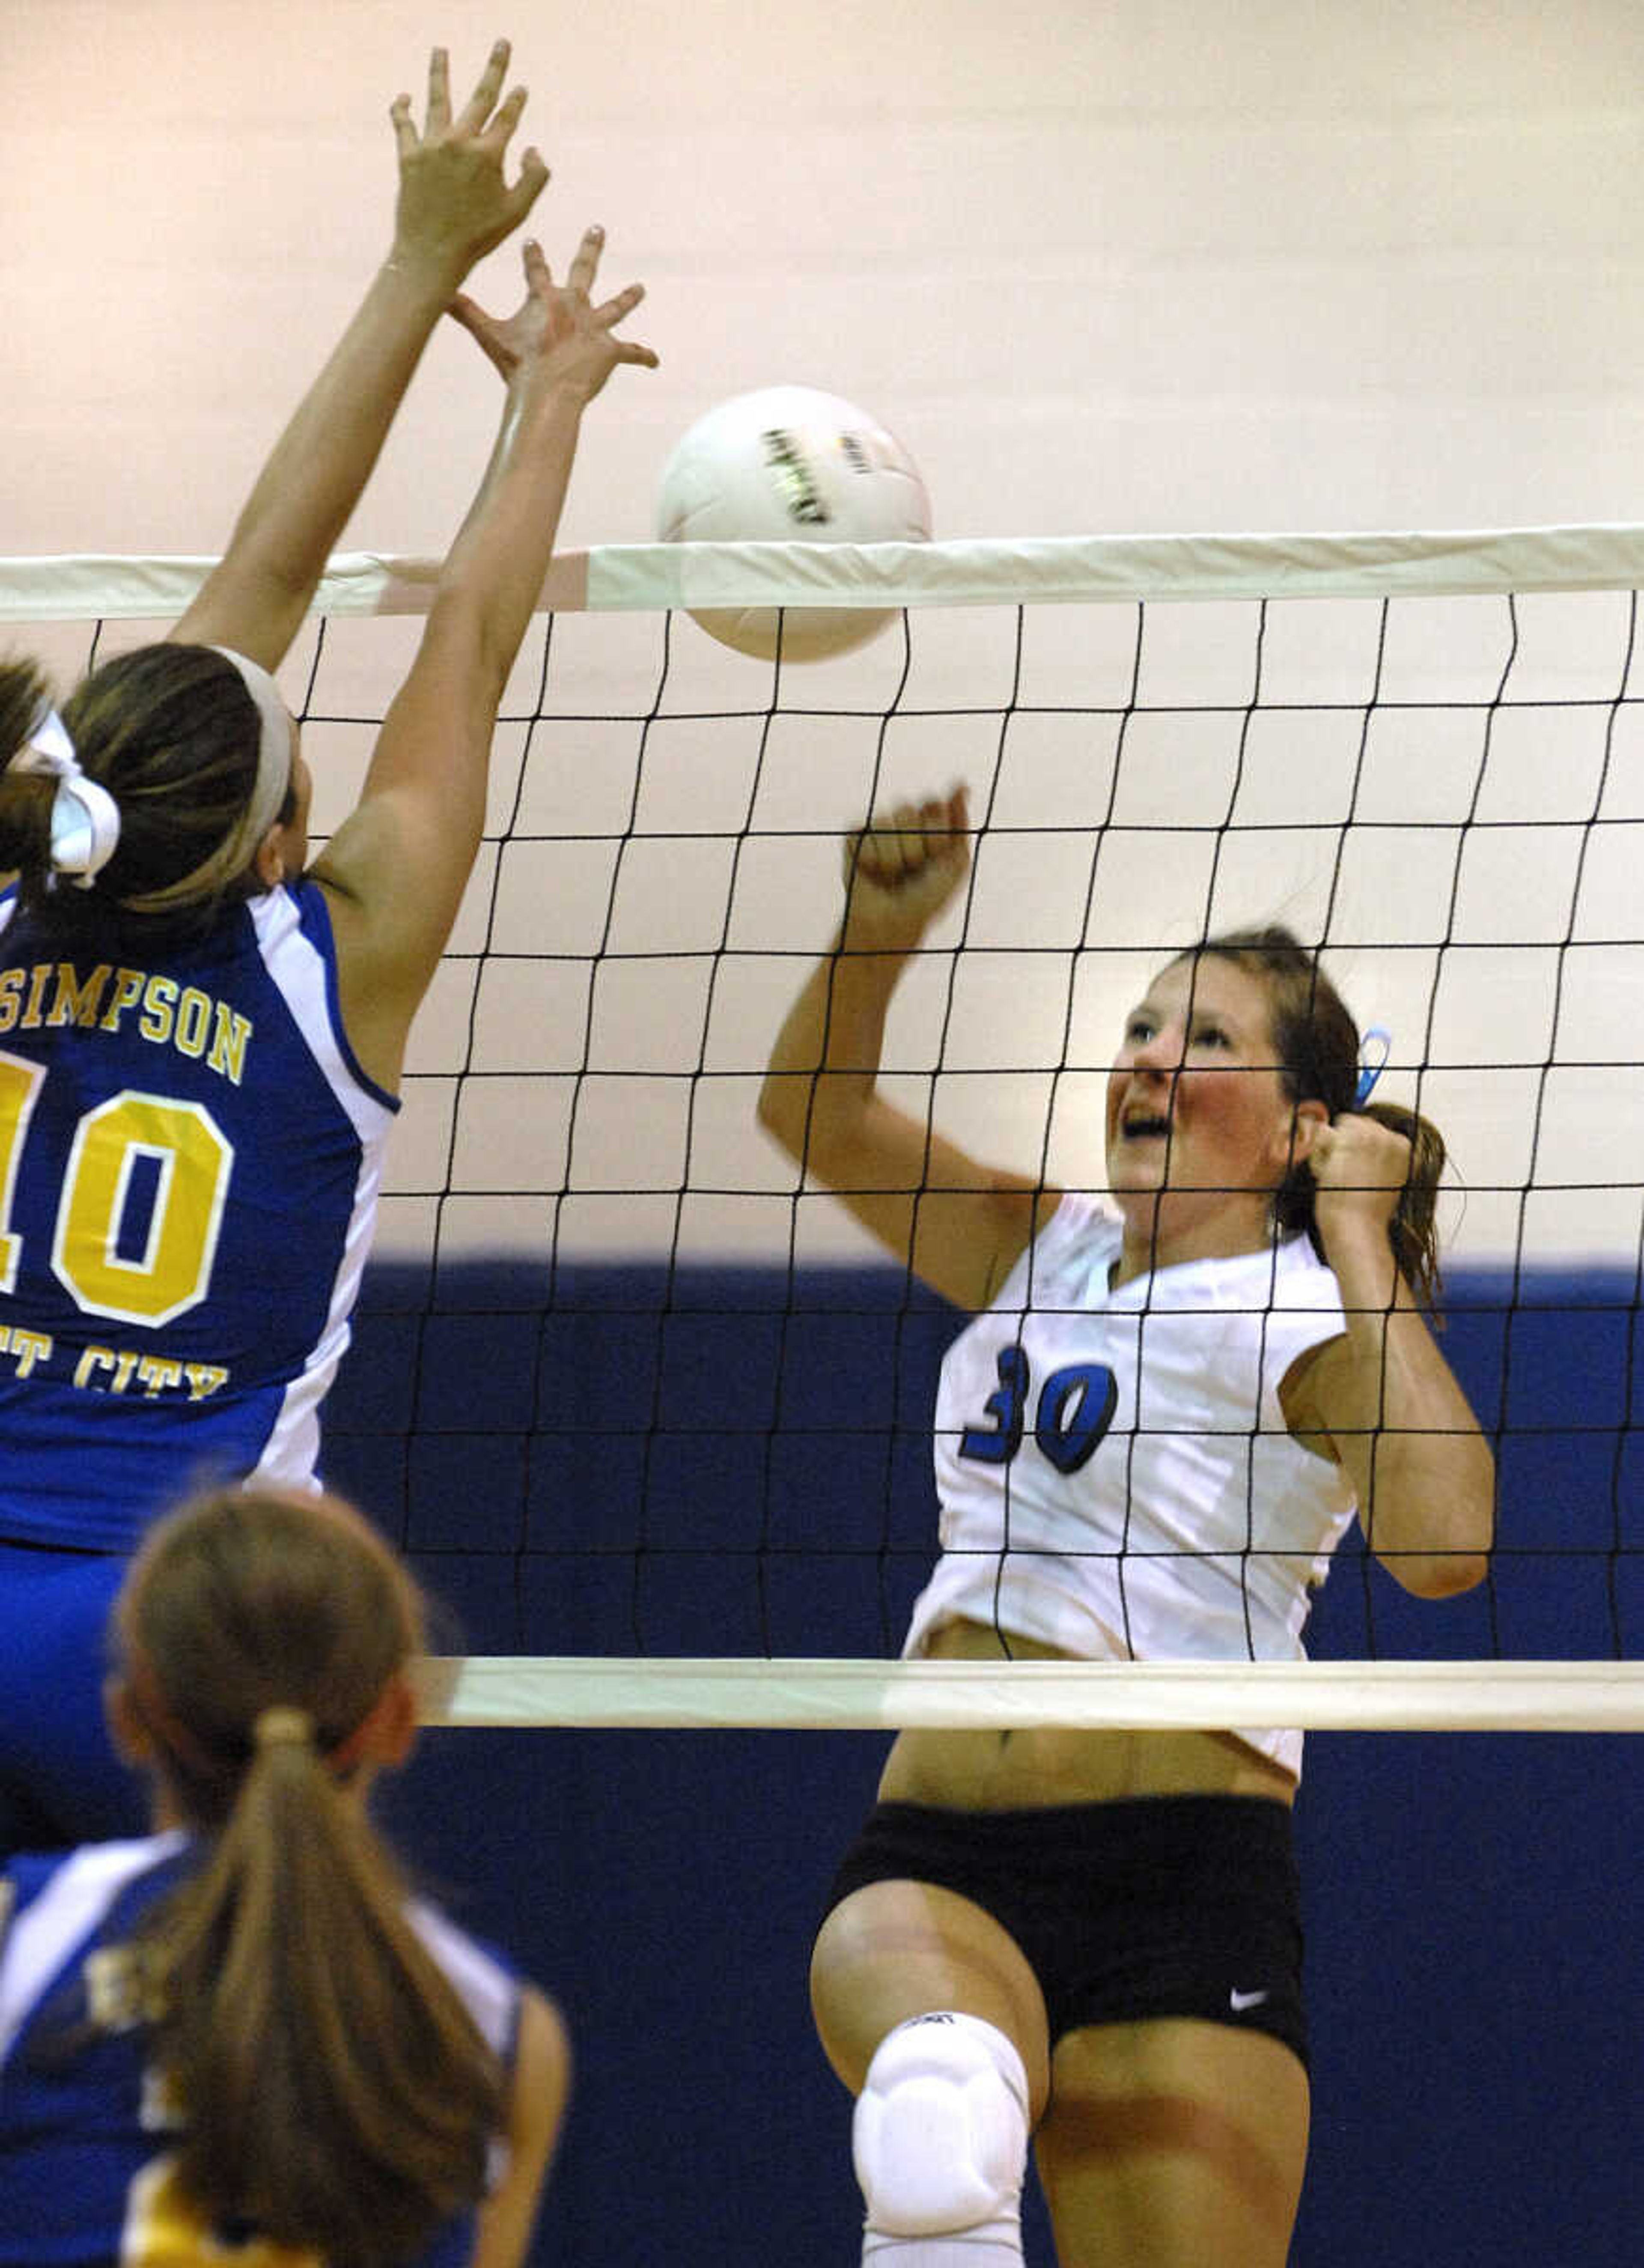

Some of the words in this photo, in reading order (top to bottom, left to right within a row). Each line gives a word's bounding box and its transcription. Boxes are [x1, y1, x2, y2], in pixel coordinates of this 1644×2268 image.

[0, 963, 253, 1086] SIMPSON
[0, 1324, 53, 1379] T
[73, 1345, 230, 1401] CITY
[958, 1346, 1118, 1475] 30
